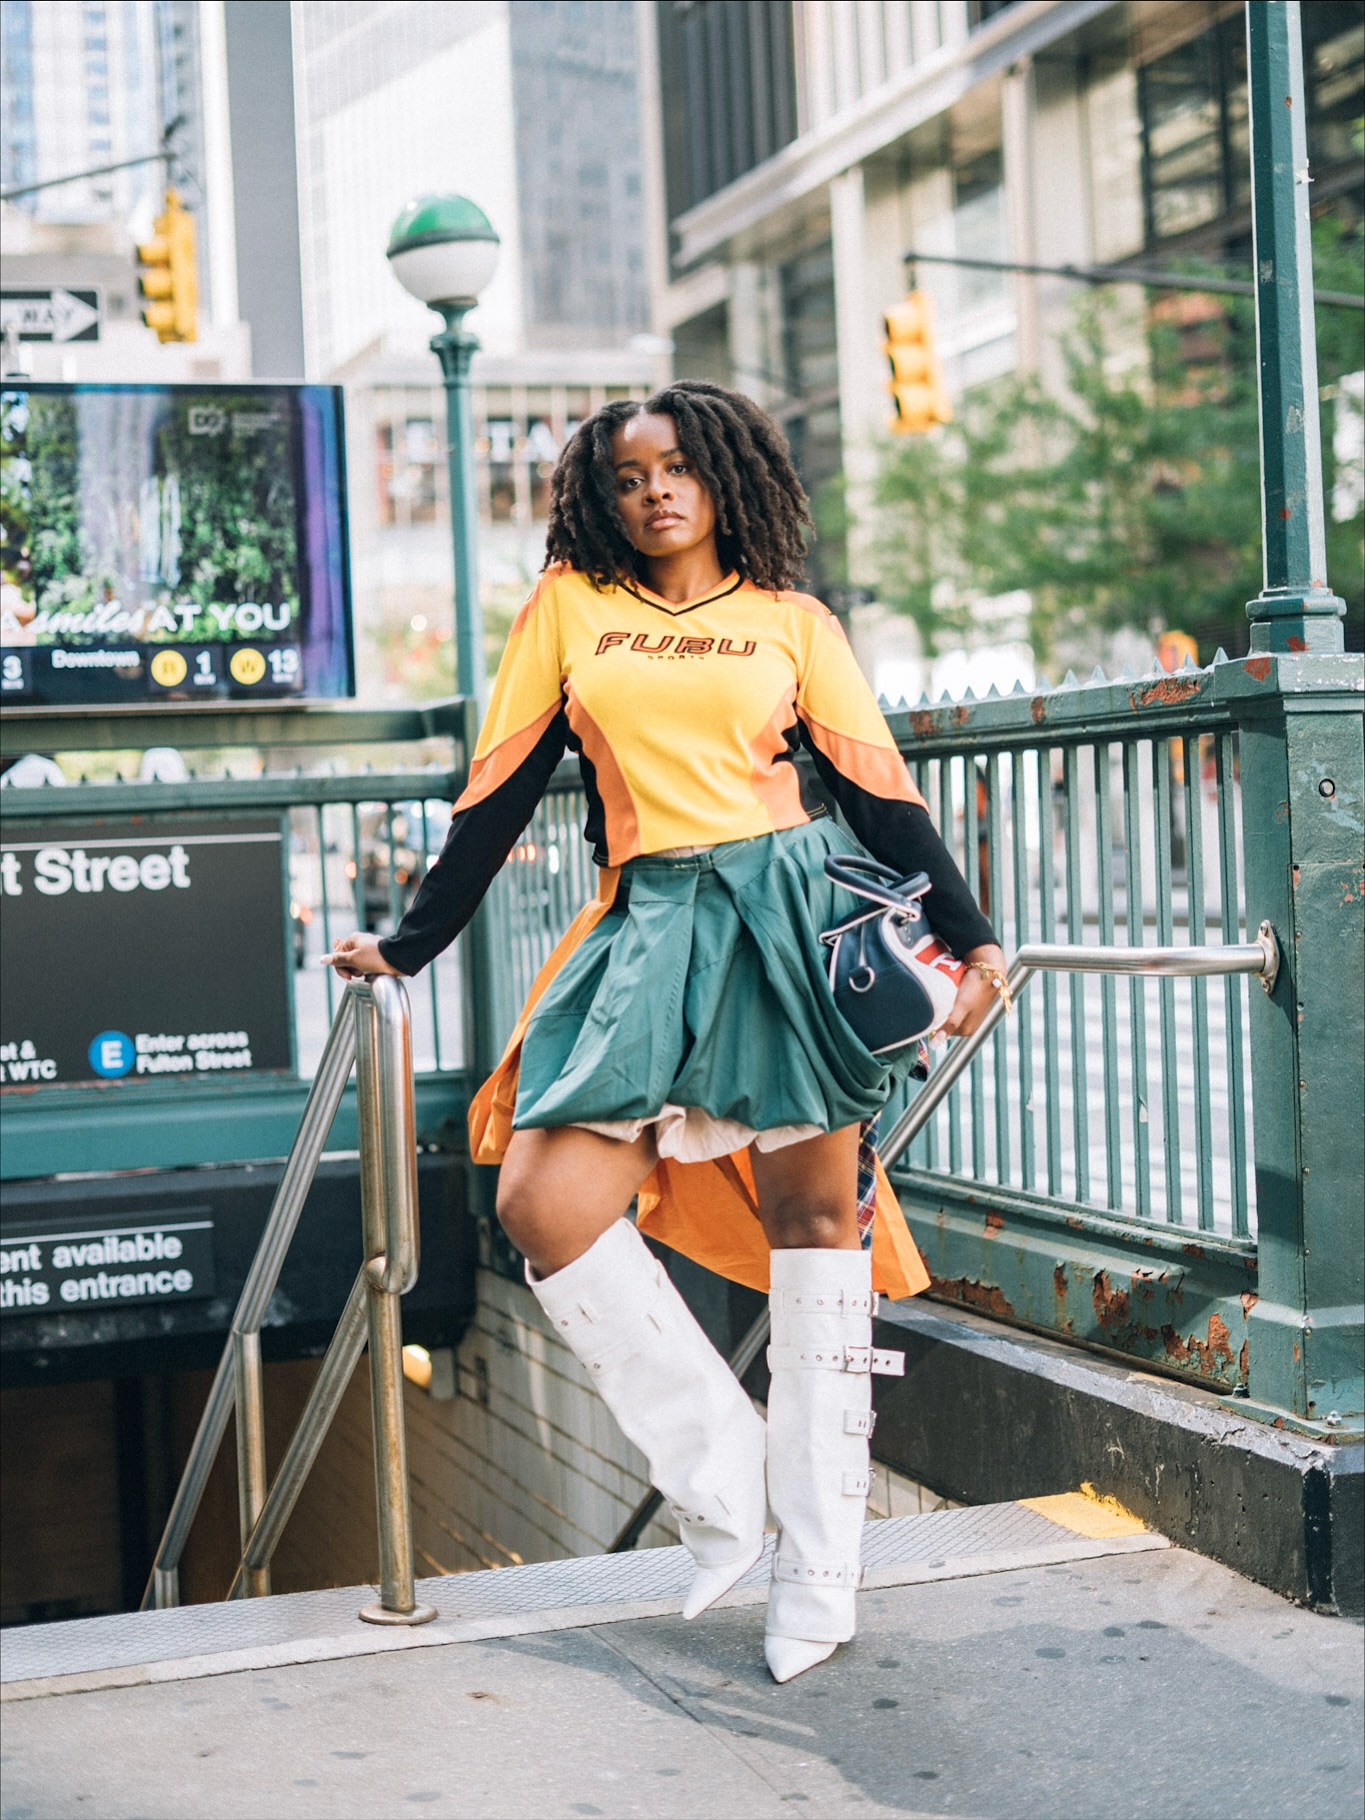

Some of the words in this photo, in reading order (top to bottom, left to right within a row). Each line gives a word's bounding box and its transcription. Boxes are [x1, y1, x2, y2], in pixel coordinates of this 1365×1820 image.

[20, 309, 74, 323] WAY
[148, 605, 201, 632] AT
[208, 603, 290, 630] YOU
[595, 632, 757, 656] FUBU
[2, 656, 22, 680] 3
[51, 650, 141, 669] Downtown
[196, 653, 211, 678] 1
[268, 649, 299, 675] 13
[0, 852, 23, 896] t
[34, 845, 191, 896] Street
[19, 1040, 36, 1060] &
[101, 1041, 123, 1069] E
[135, 1034, 185, 1054] Enter
[187, 1032, 249, 1050] across
[8, 1059, 57, 1081] WTC
[136, 1053, 194, 1074] Fulton
[195, 1049, 252, 1070] Street
[52, 1232, 183, 1269] available
[60, 1269, 193, 1302] entrance
